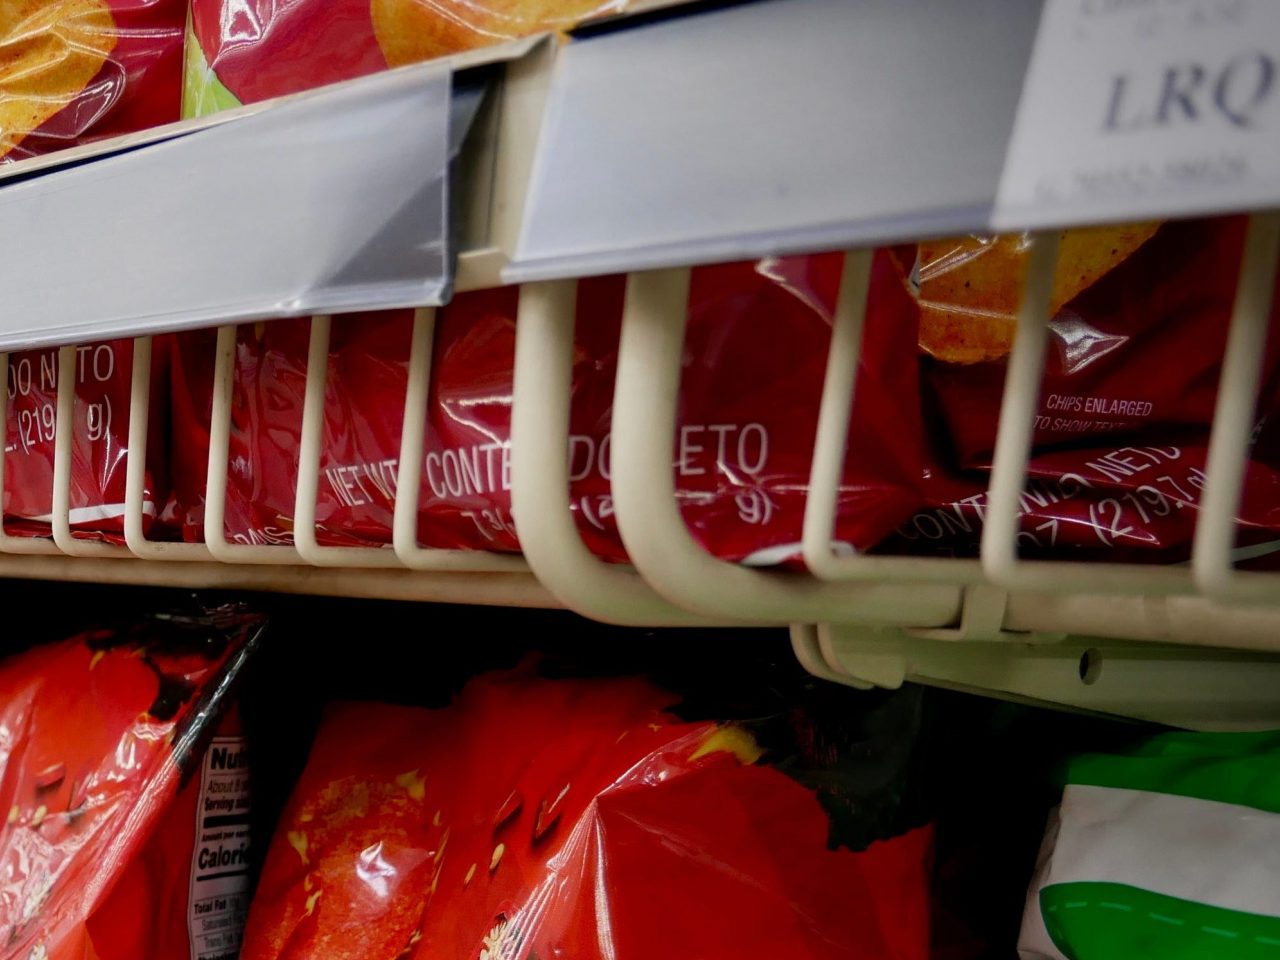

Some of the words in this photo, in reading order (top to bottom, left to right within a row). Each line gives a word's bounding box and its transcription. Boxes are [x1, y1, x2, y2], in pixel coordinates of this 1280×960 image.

[41, 345, 114, 391] NTO
[1047, 394, 1082, 412] CHIPS
[1085, 398, 1153, 416] ENLARGED
[680, 423, 768, 476] ETO
[194, 901, 212, 915] Total
